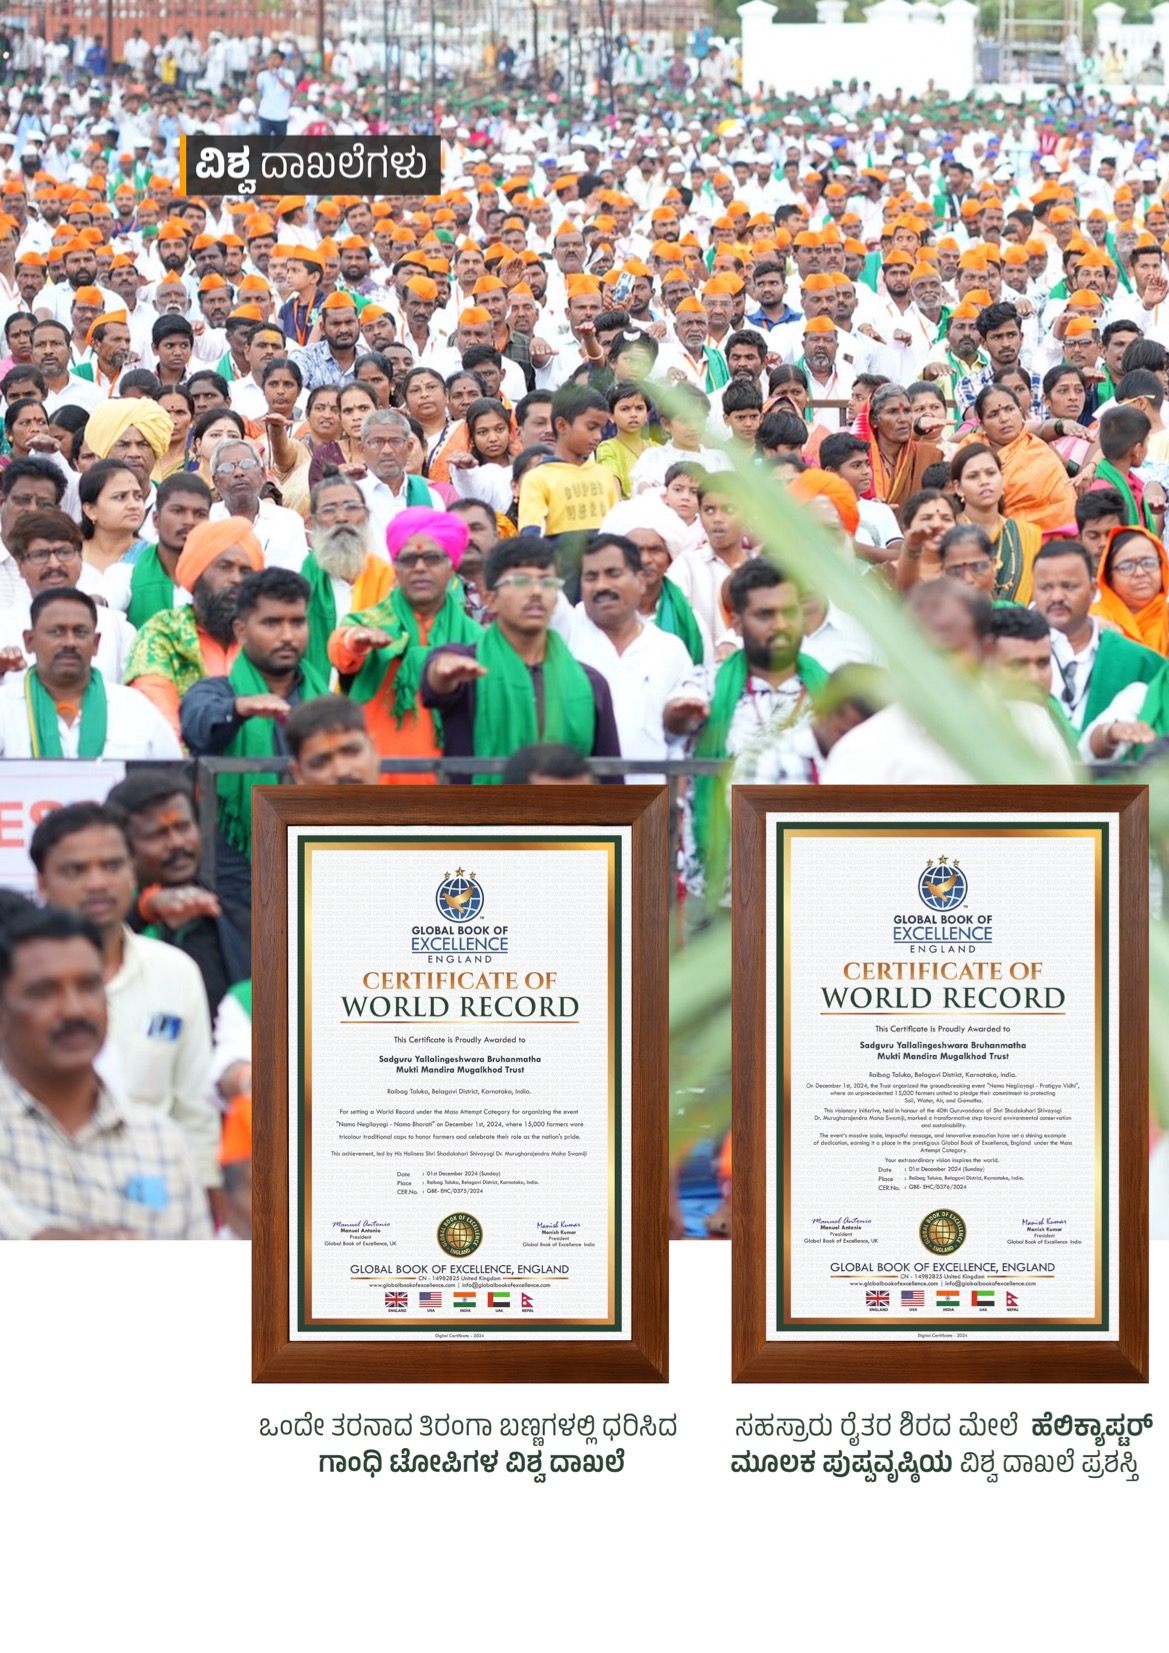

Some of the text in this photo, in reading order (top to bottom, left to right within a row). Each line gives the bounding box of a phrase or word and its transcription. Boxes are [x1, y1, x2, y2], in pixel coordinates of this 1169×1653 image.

[893, 914, 993, 925] GLOBAL BOOK OF
[411, 925, 509, 936] GLOBAL BOOK OF
[893, 926, 993, 941] EXCELLENCE
[411, 936, 509, 951] EXCELLENCE
[910, 944, 976, 954] ENGLAND
[428, 955, 492, 964] ENGLAND
[843, 961, 1043, 980] CERTIFICATE OF
[362, 971, 557, 990] CERTIFICATE OF
[821, 986, 1066, 1009] WORLD RECORD
[341, 996, 579, 1018] WORLD RECORD
[875, 1025, 889, 1033] This
[890, 1024, 929, 1033] Certificate
[937, 1025, 966, 1034] Proudly
[967, 1025, 1002, 1033] Awarded
[408, 1035, 446, 1044] Certificate
[455, 1036, 482, 1045] Proudly
[483, 1036, 517, 1044] Awarded
[859, 1041, 1027, 1051] Sadguru Yallalingeshwara Bruhanmatha
[378, 1055, 542, 1065] Sadguru Yallalingeshwara Bruhanmatha
[877, 1052, 1010, 1062] Mukti Mandira Mugalkhod Trust
[395, 1065, 525, 1075] Mukti Mandira Mugalkhod Trust
[387, 1088, 408, 1096] Raibag
[431, 1088, 458, 1096] Belagavi
[350, 1264, 570, 1276] GLOBAL BOOK OF EXCELLENCE, ENGLAND
[830, 1262, 1056, 1274] GLOBAL BOOK OF EXCELLENCE, ENGLAND
